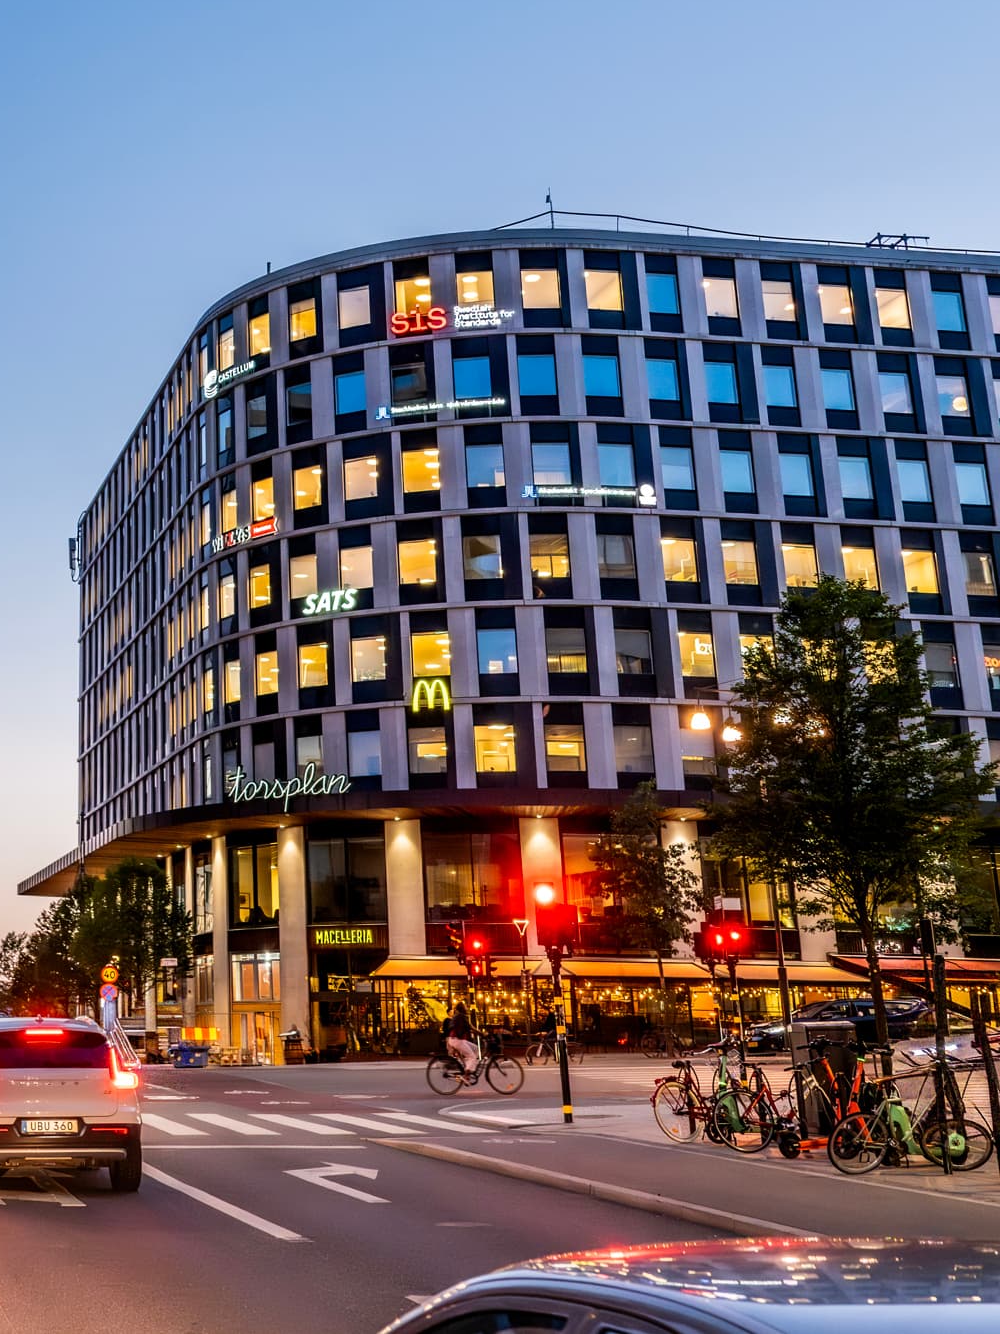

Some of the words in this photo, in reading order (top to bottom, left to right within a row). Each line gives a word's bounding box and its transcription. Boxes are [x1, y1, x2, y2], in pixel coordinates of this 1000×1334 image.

[218, 360, 255, 384] CASTELLUM
[302, 588, 358, 615] SATS
[228, 762, 352, 813] torsplan
[315, 929, 373, 945] MACELLERIA
[104, 970, 116, 980] 40
[30, 1121, 50, 1131] UBU
[53, 1121, 73, 1131] 360
